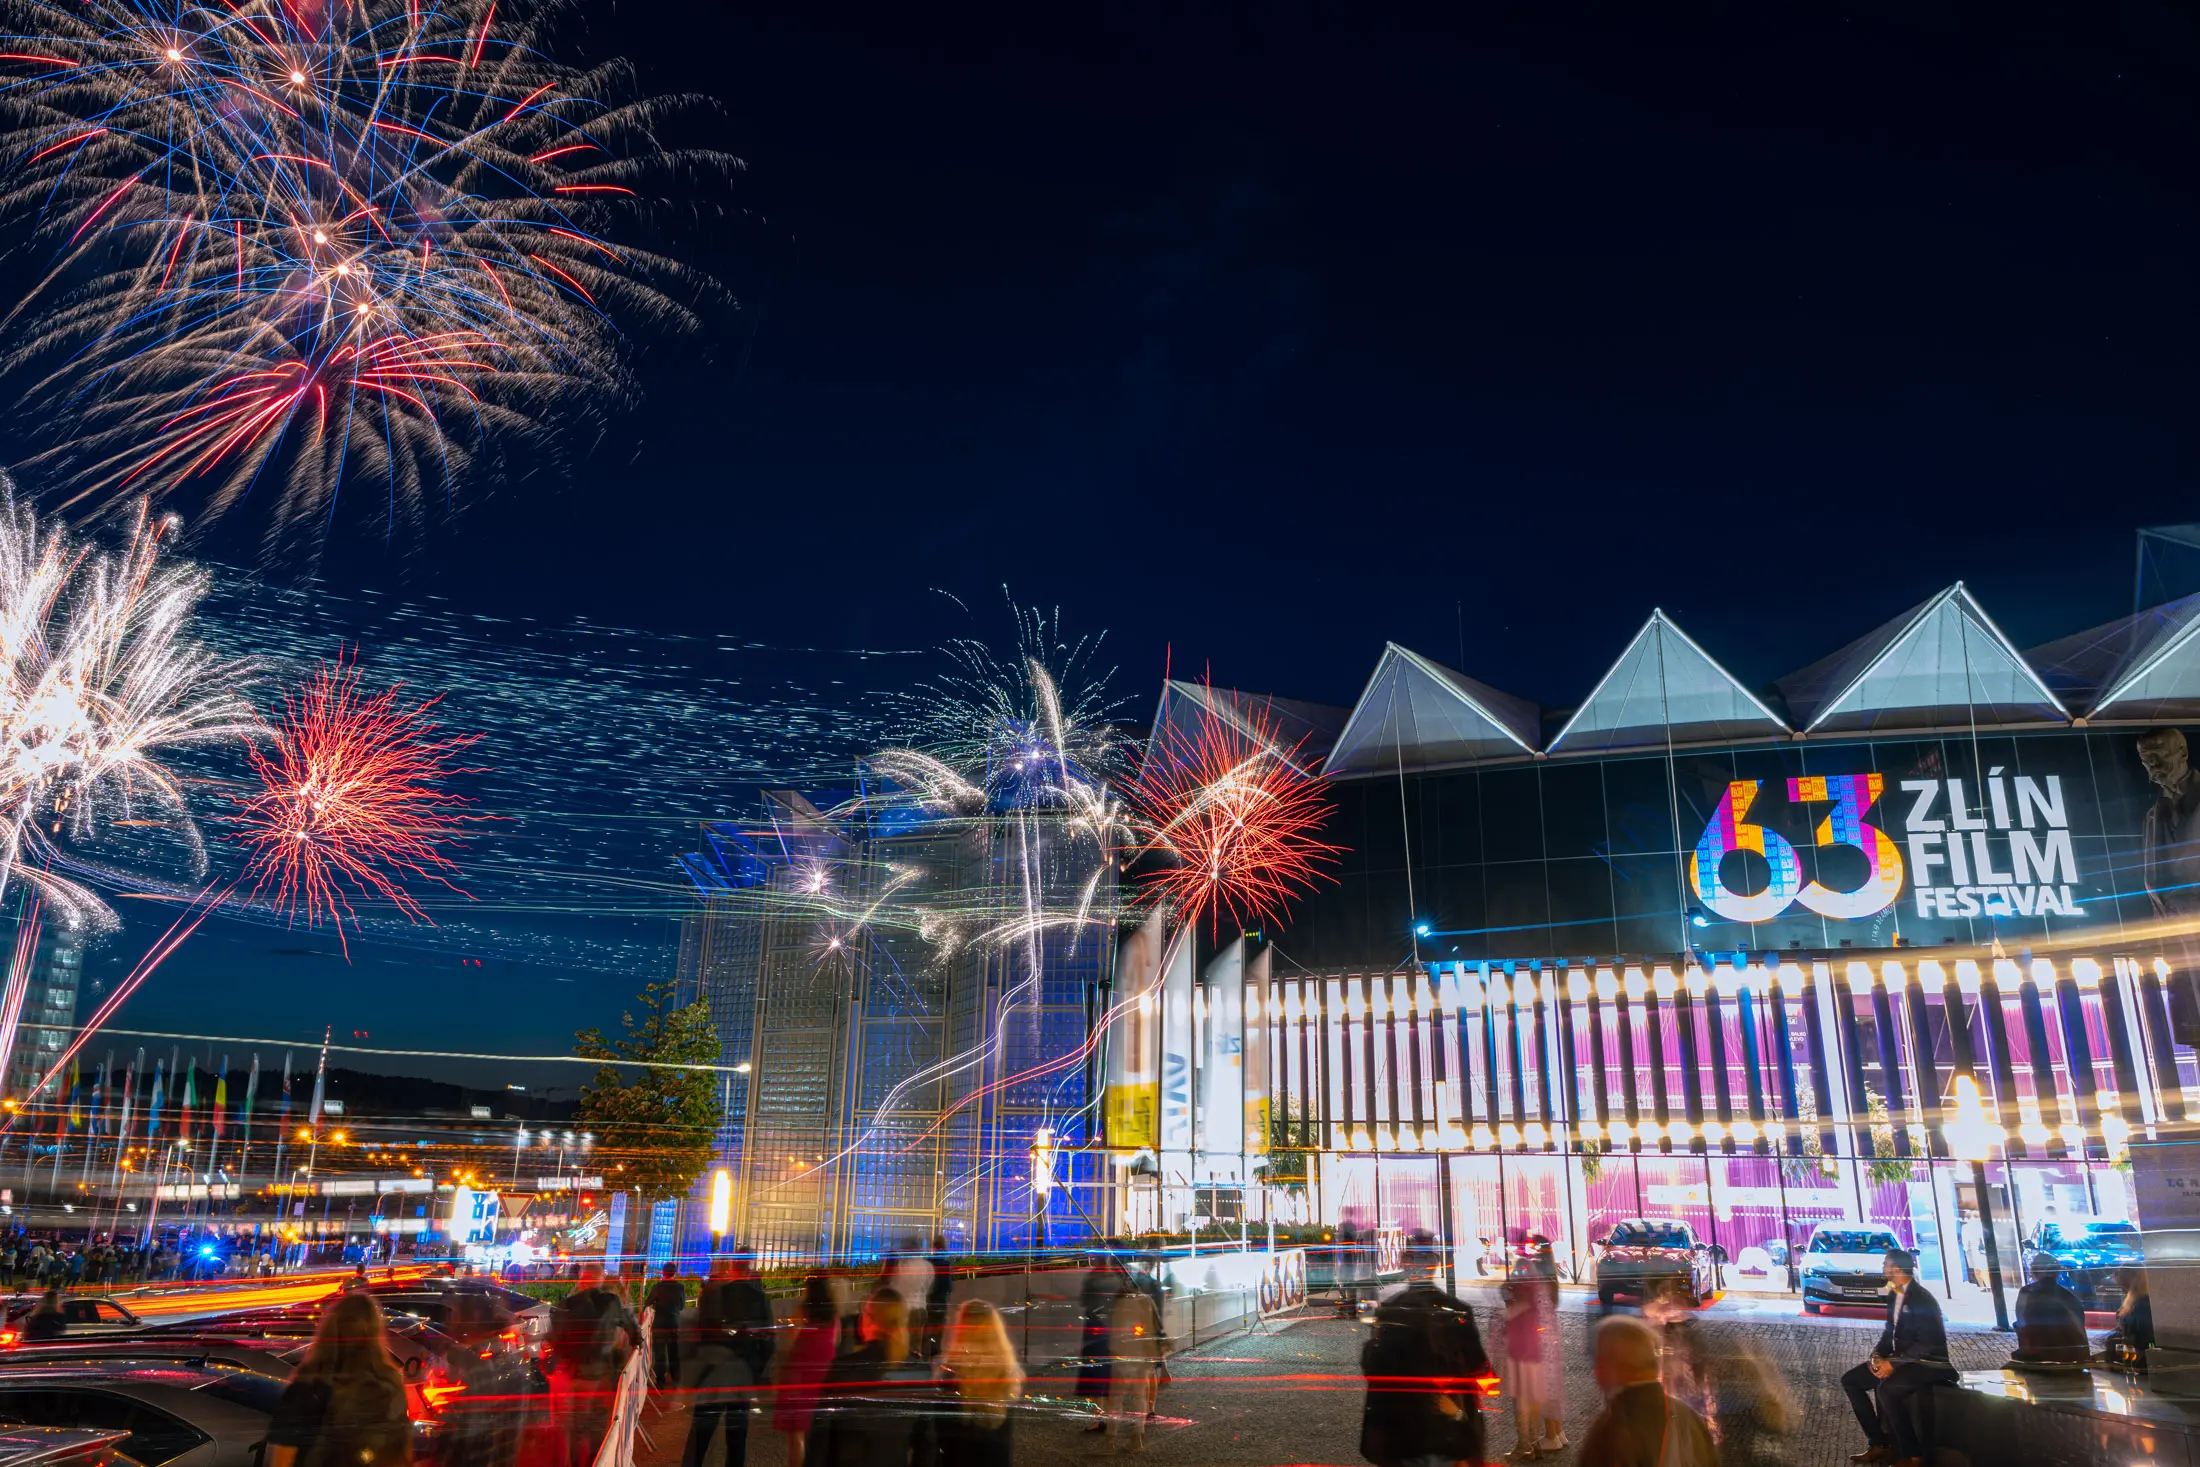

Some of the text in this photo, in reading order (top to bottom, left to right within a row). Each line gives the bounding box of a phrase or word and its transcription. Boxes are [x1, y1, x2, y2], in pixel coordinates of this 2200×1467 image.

[1900, 767, 2068, 832] ZLÍN
[1690, 773, 1904, 922] 63
[1906, 830, 2078, 886] FILM
[1915, 885, 2084, 918] FESTIVAL
